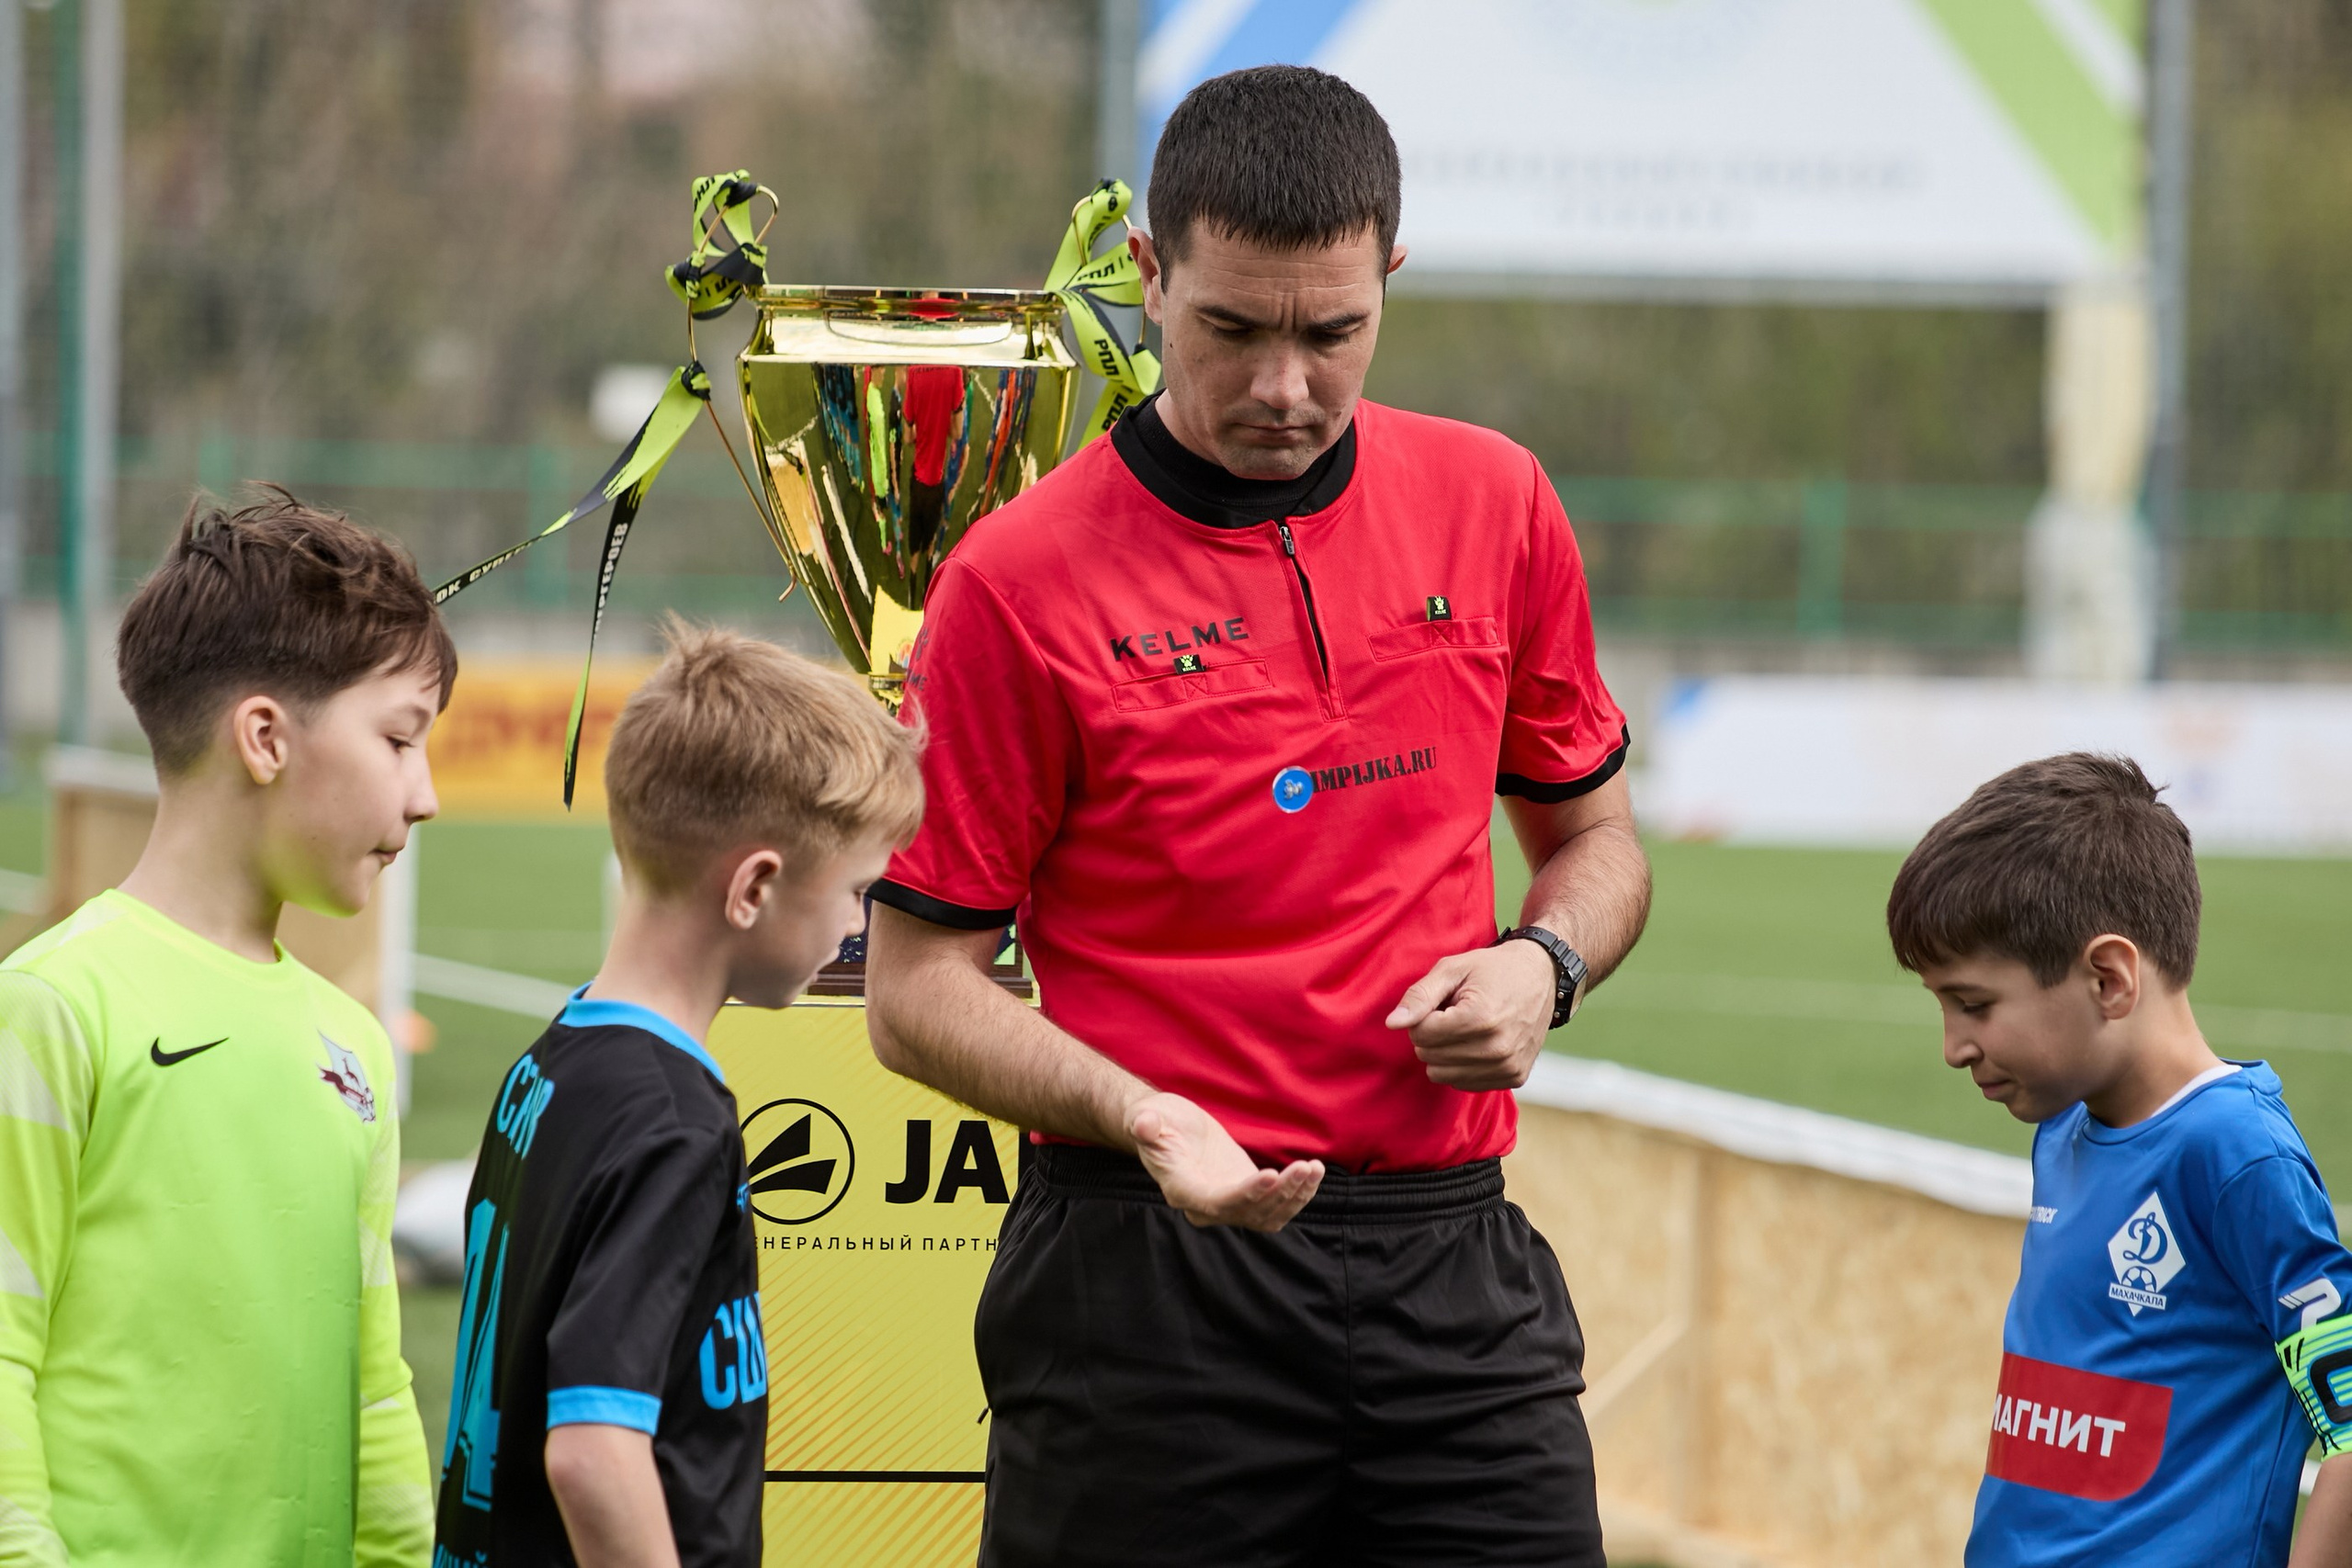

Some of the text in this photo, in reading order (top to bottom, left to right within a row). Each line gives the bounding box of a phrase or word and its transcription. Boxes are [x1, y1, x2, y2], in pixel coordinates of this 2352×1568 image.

[1111, 617, 1250, 661] KELME
[754, 1235, 911, 1250] НЕРАЛЬНЫЙ
[2110, 1287, 2164, 1307] МАХАЧКАЛА
